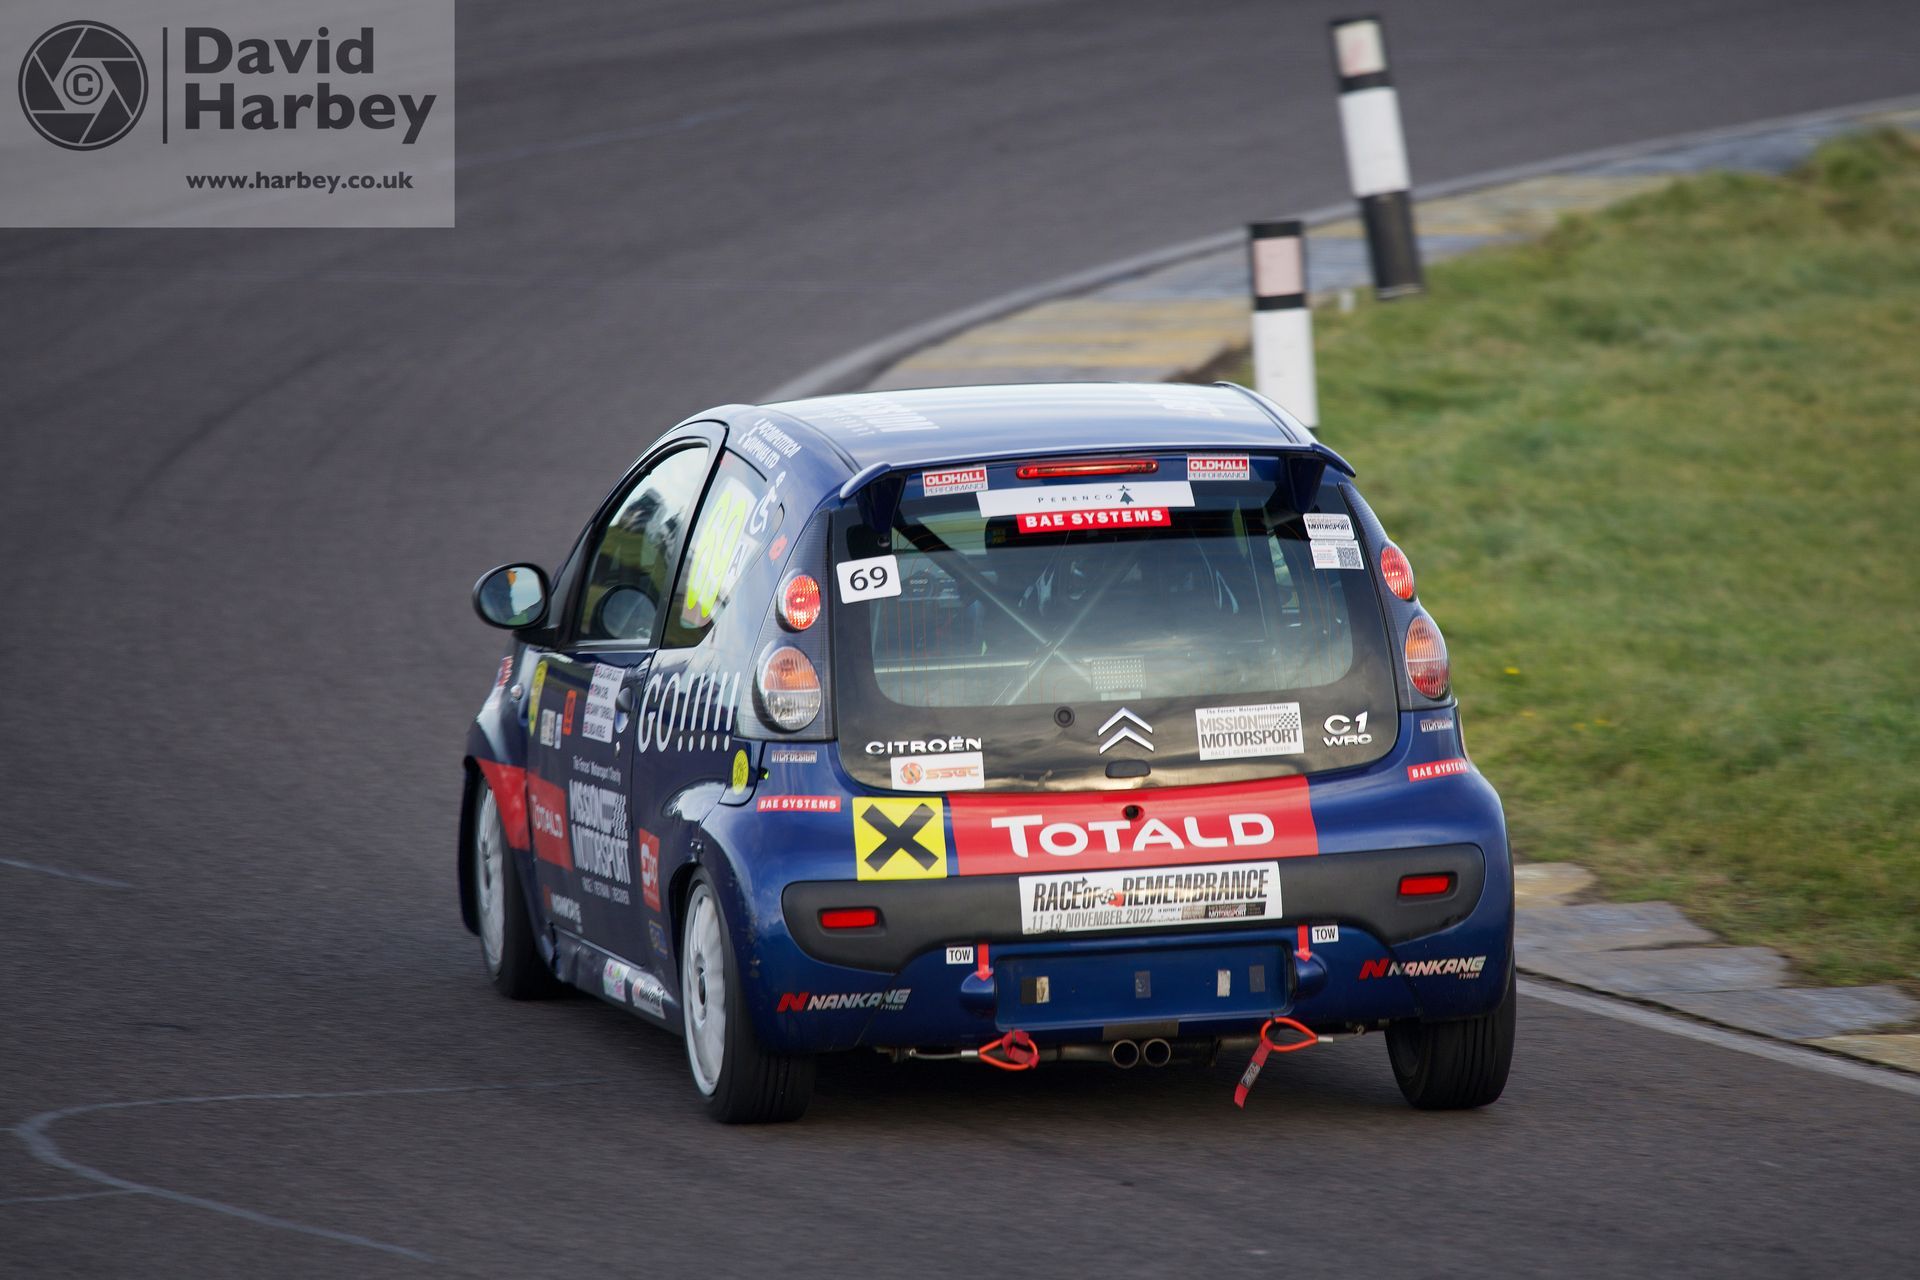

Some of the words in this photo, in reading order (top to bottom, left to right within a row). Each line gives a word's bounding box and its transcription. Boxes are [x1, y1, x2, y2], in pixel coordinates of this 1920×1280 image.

[1190, 460, 1248, 472] OLDHALL
[925, 471, 985, 486] OLDHALL
[1190, 472, 1249, 480] PERFORMANCE
[925, 482, 987, 494] PERFORMANCE
[1037, 493, 1114, 504] PERENCO
[1025, 514, 1065, 528] BAE
[1071, 509, 1164, 526] SYSTEMS
[849, 565, 889, 592] 69
[637, 671, 741, 754] GO!!!!!
[1200, 715, 1259, 733] MISSION
[1322, 710, 1368, 736] C1
[865, 735, 983, 756] CITROËN
[1200, 728, 1300, 749] MOTORSPORT
[1411, 764, 1433, 779] BAE
[760, 797, 779, 809] BAE
[782, 797, 837, 810] SYSTEMS
[990, 812, 1276, 859] TOTALD
[1032, 880, 1084, 913] RACE
[1083, 887, 1102, 910] OF
[1122, 869, 1270, 907] REMEMBRANCE
[1031, 913, 1063, 931] 11-13
[1065, 910, 1122, 929] NOVEMBER
[1125, 907, 1153, 925] 2022
[1315, 928, 1336, 941] TOW
[948, 950, 971, 962] TOW
[1387, 955, 1487, 977] NANKANG
[807, 988, 912, 1011] NANKANG
